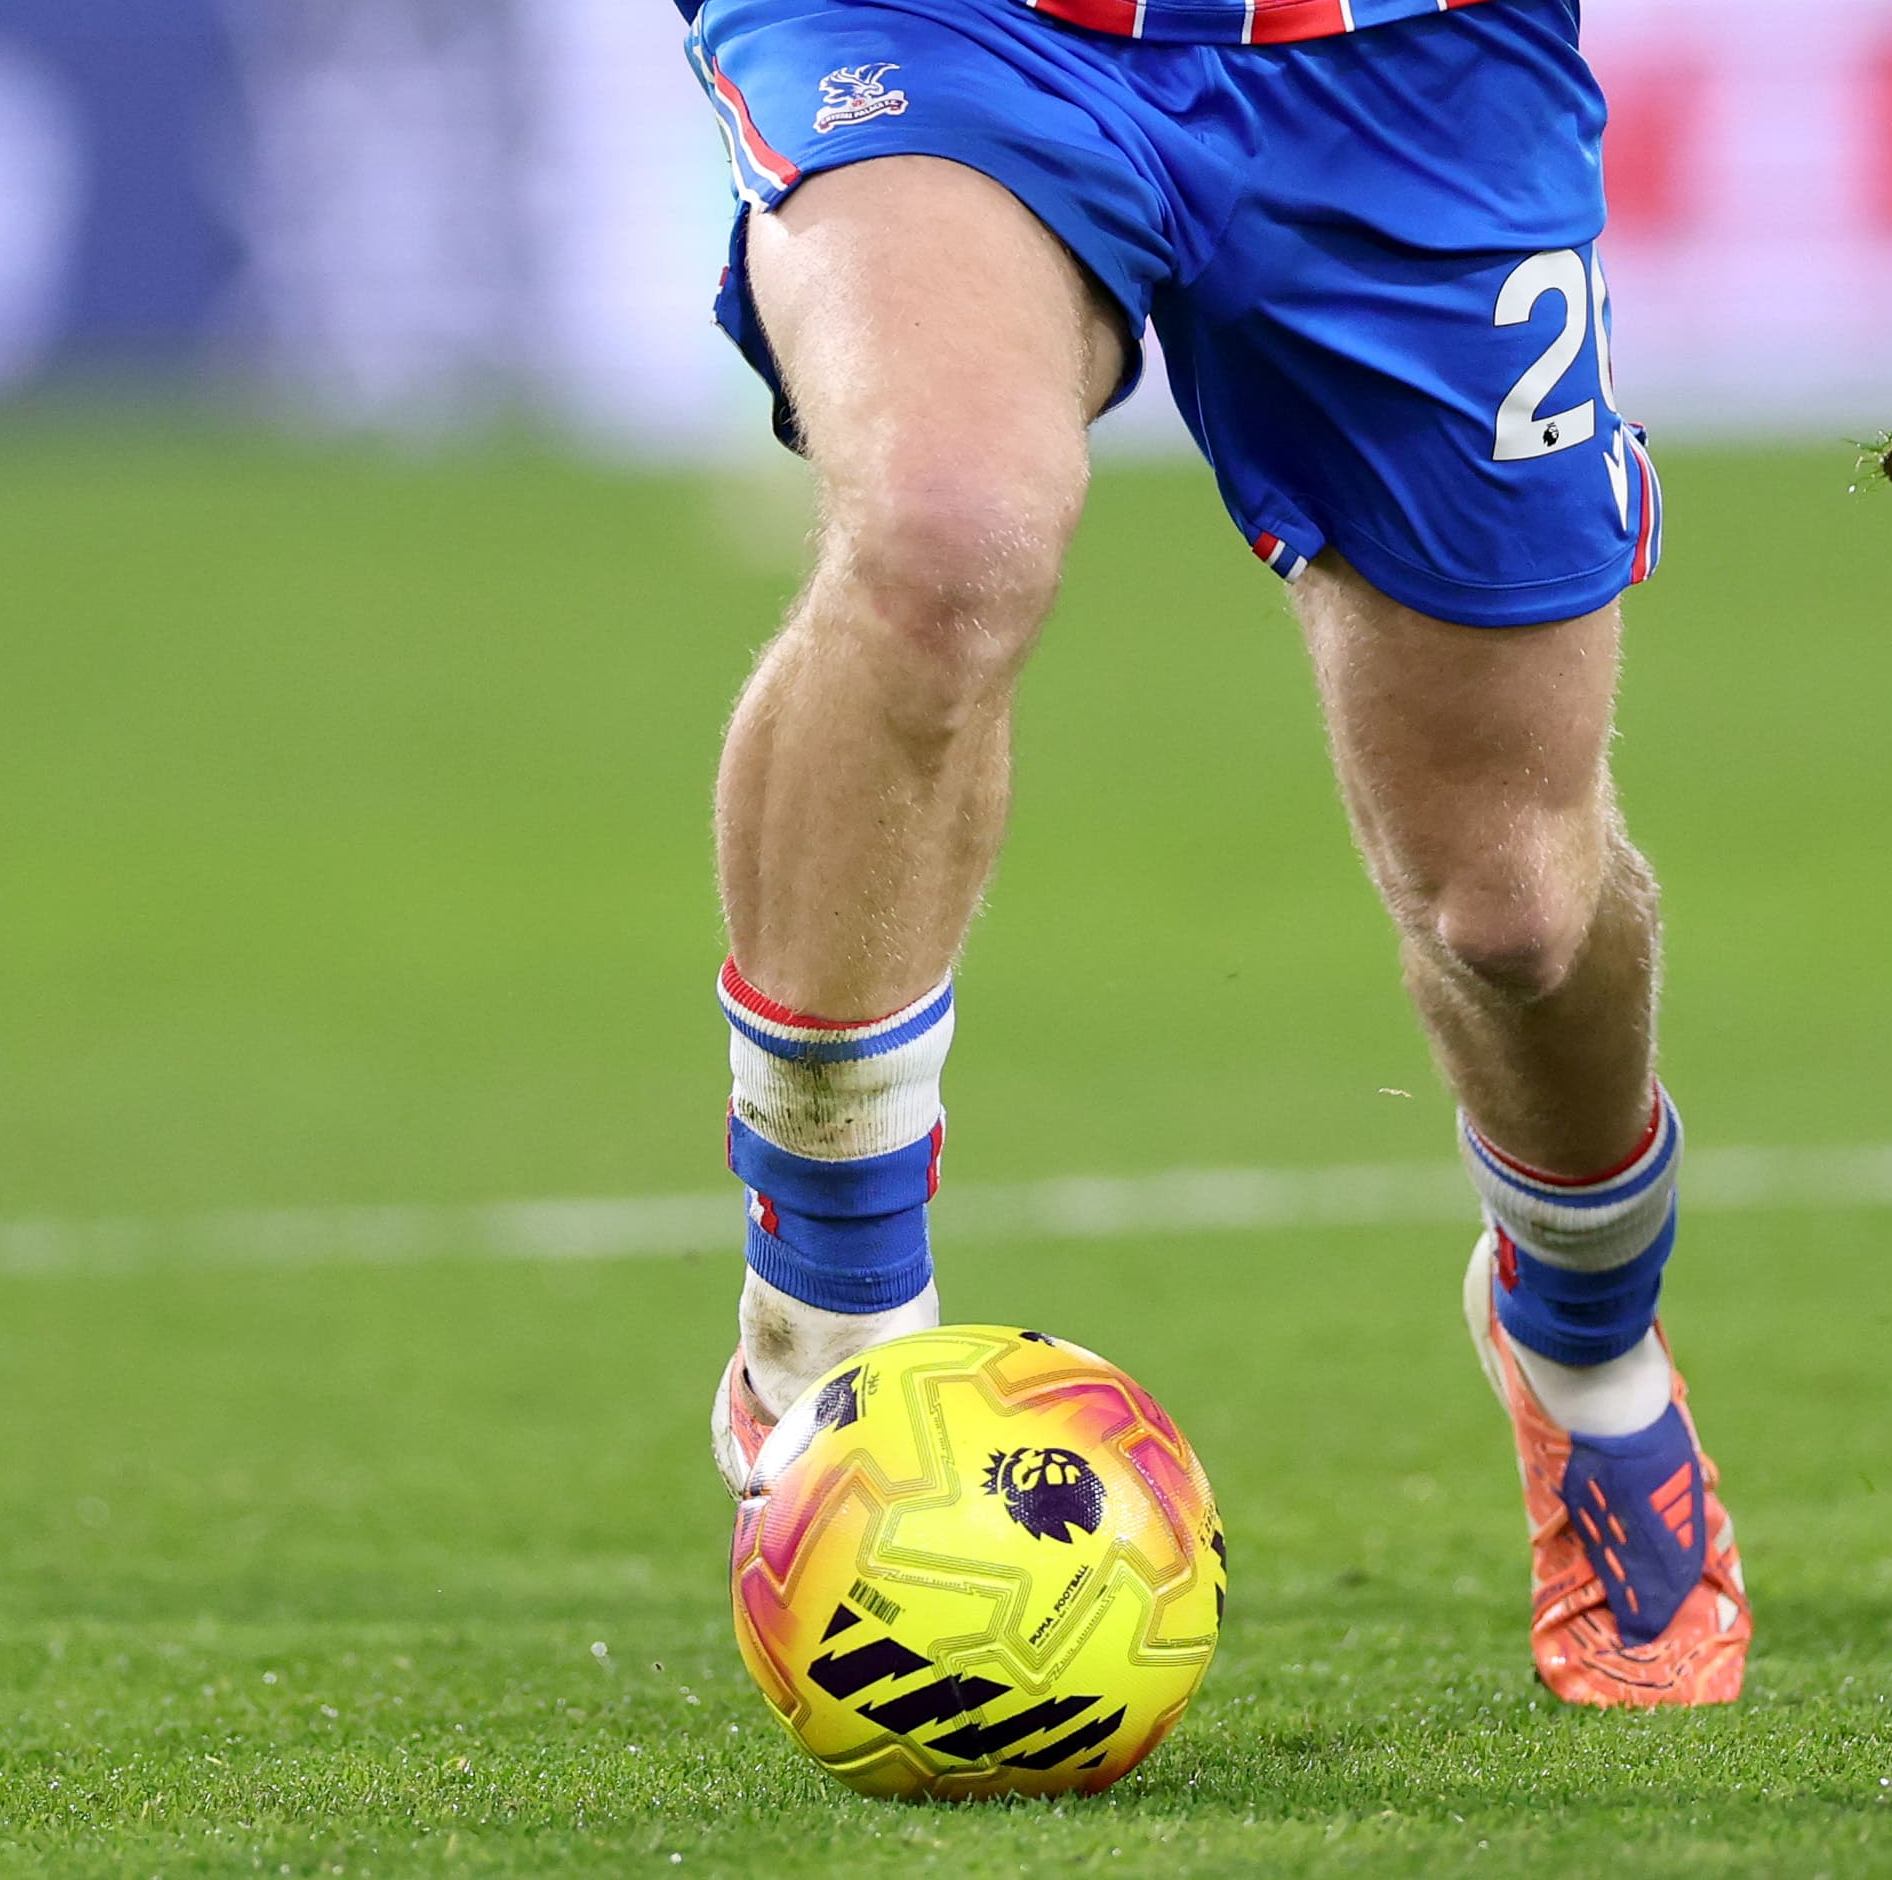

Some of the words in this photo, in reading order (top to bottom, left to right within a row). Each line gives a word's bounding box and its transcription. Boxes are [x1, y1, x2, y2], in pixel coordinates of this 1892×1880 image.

[1492, 246, 1617, 461] 2
[1028, 1617, 1054, 1645] PUMA
[1053, 1564, 1089, 1612] FOOTBALL
